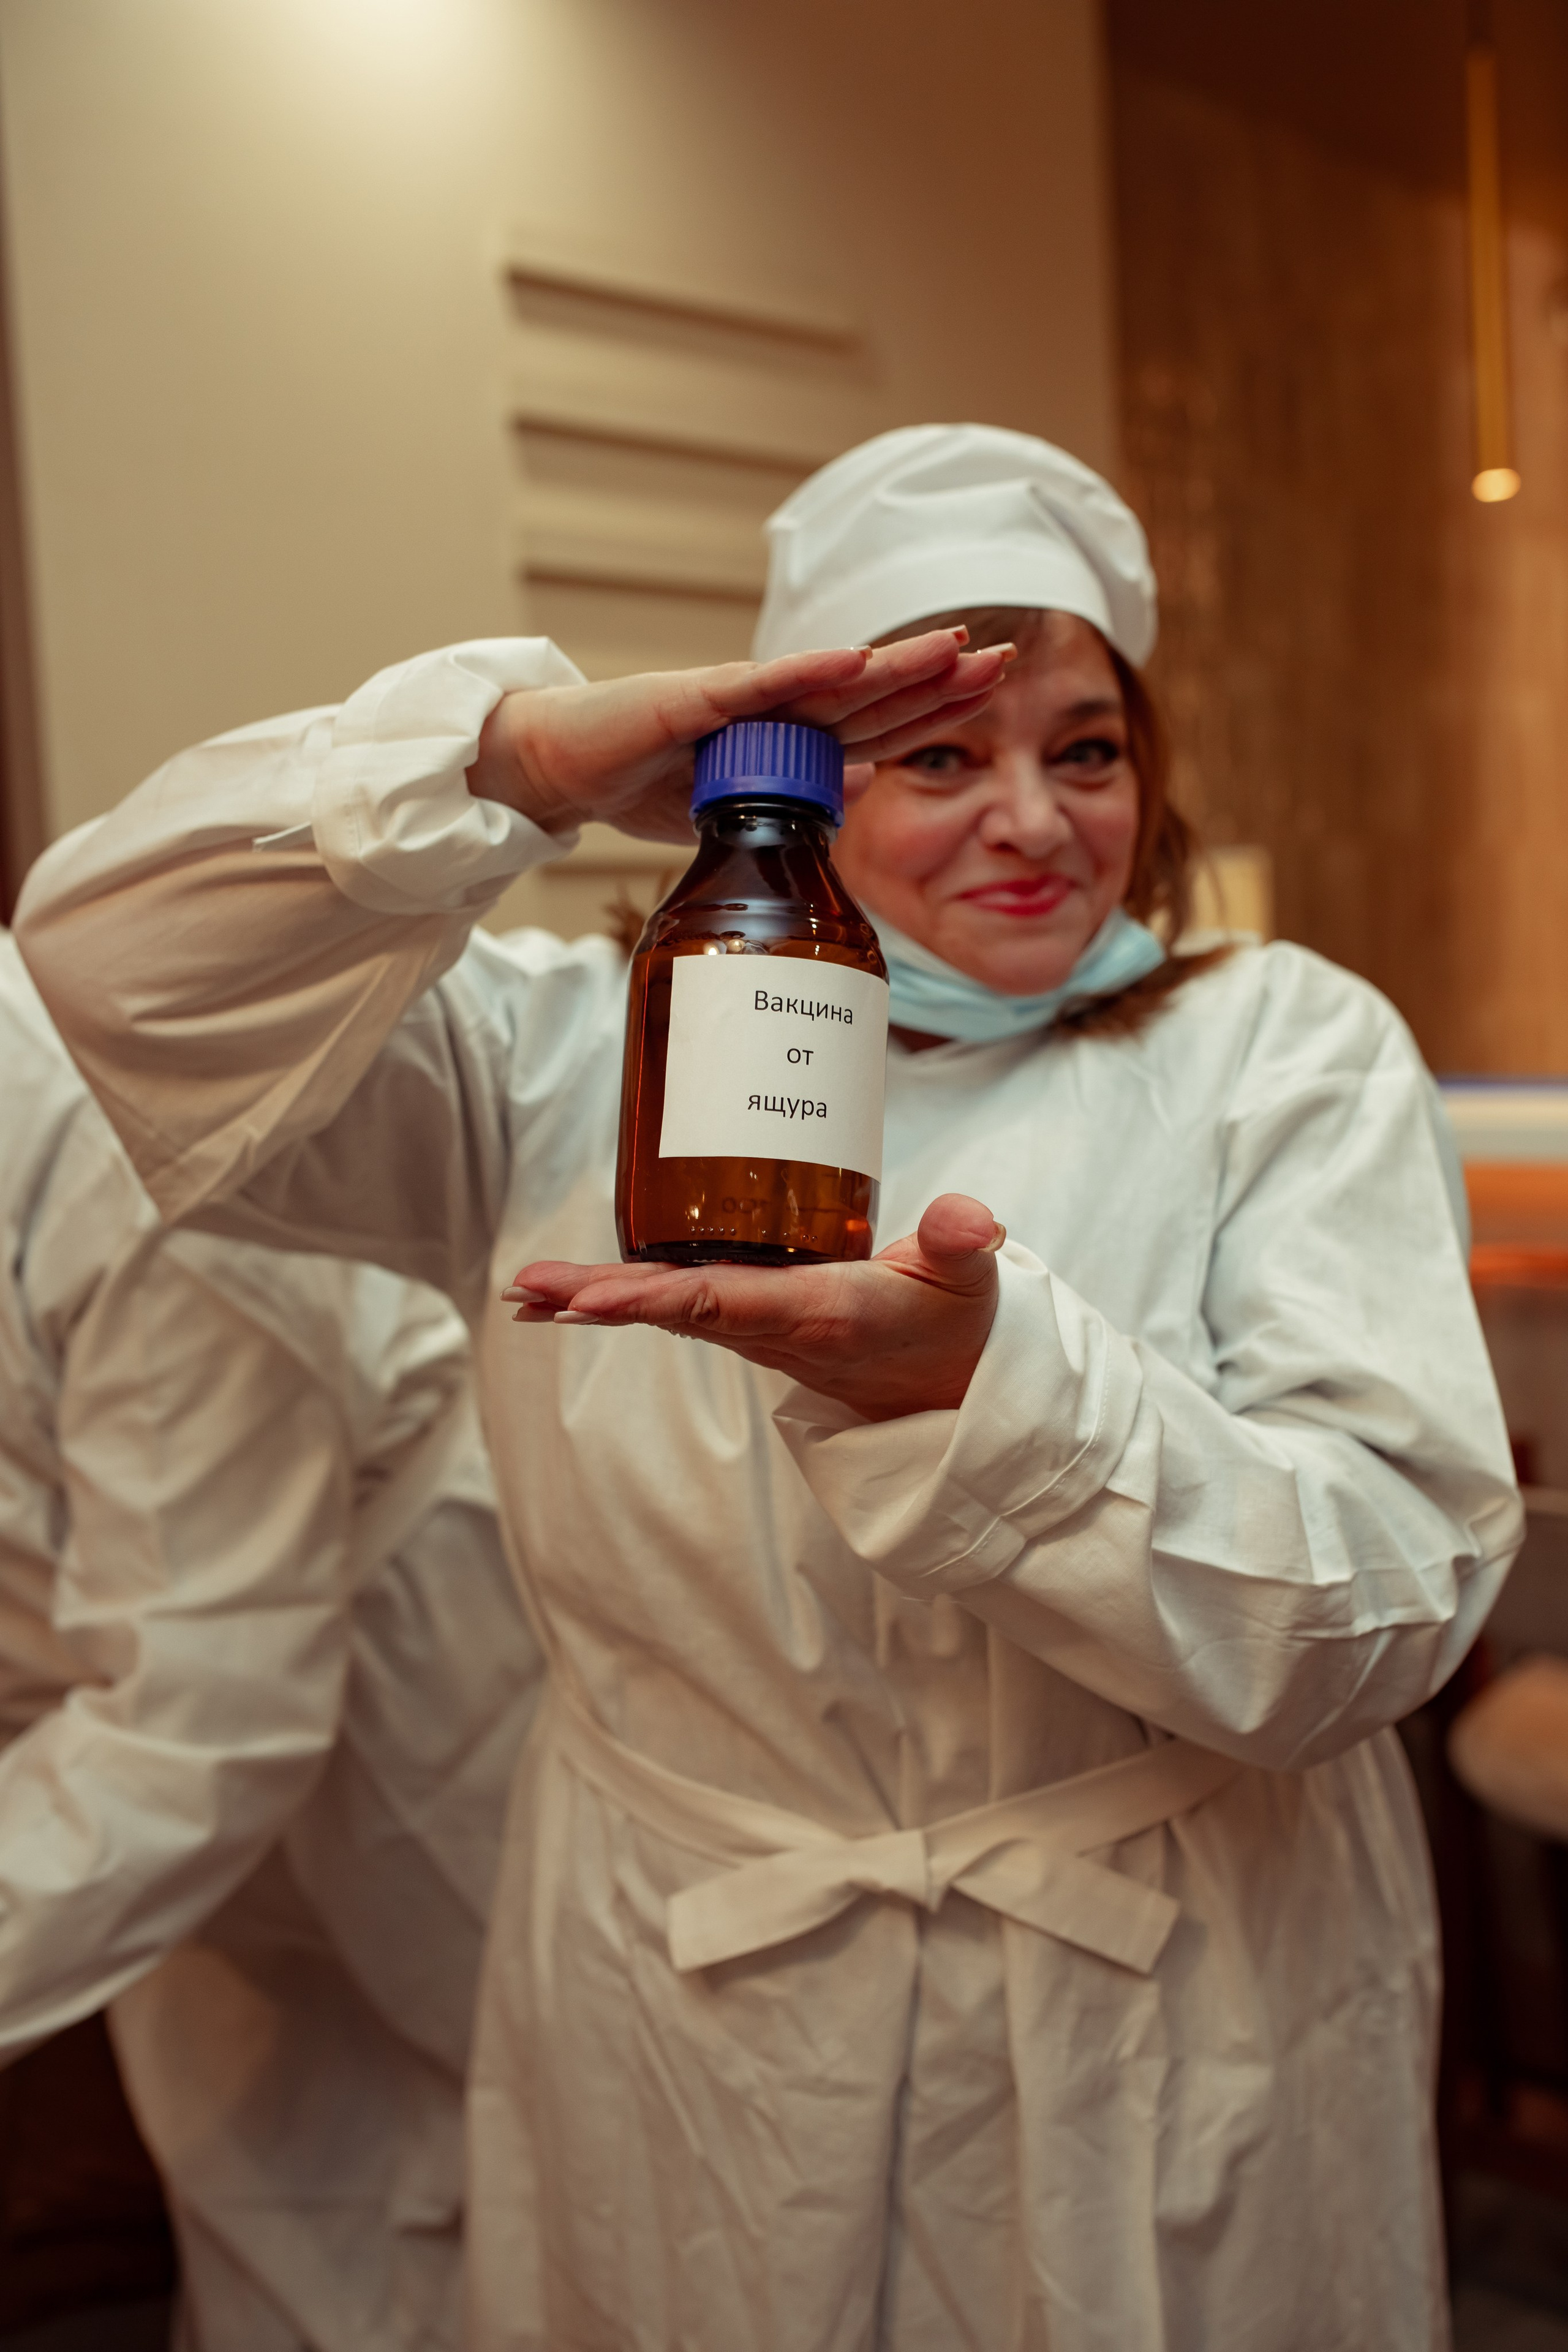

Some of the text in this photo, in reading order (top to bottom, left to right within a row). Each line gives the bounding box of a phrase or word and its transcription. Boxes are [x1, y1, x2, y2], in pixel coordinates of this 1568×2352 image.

[754, 990, 853, 1025] Вакцина
[786, 1048, 814, 1066] от
[747, 1095, 827, 1120] ящура
